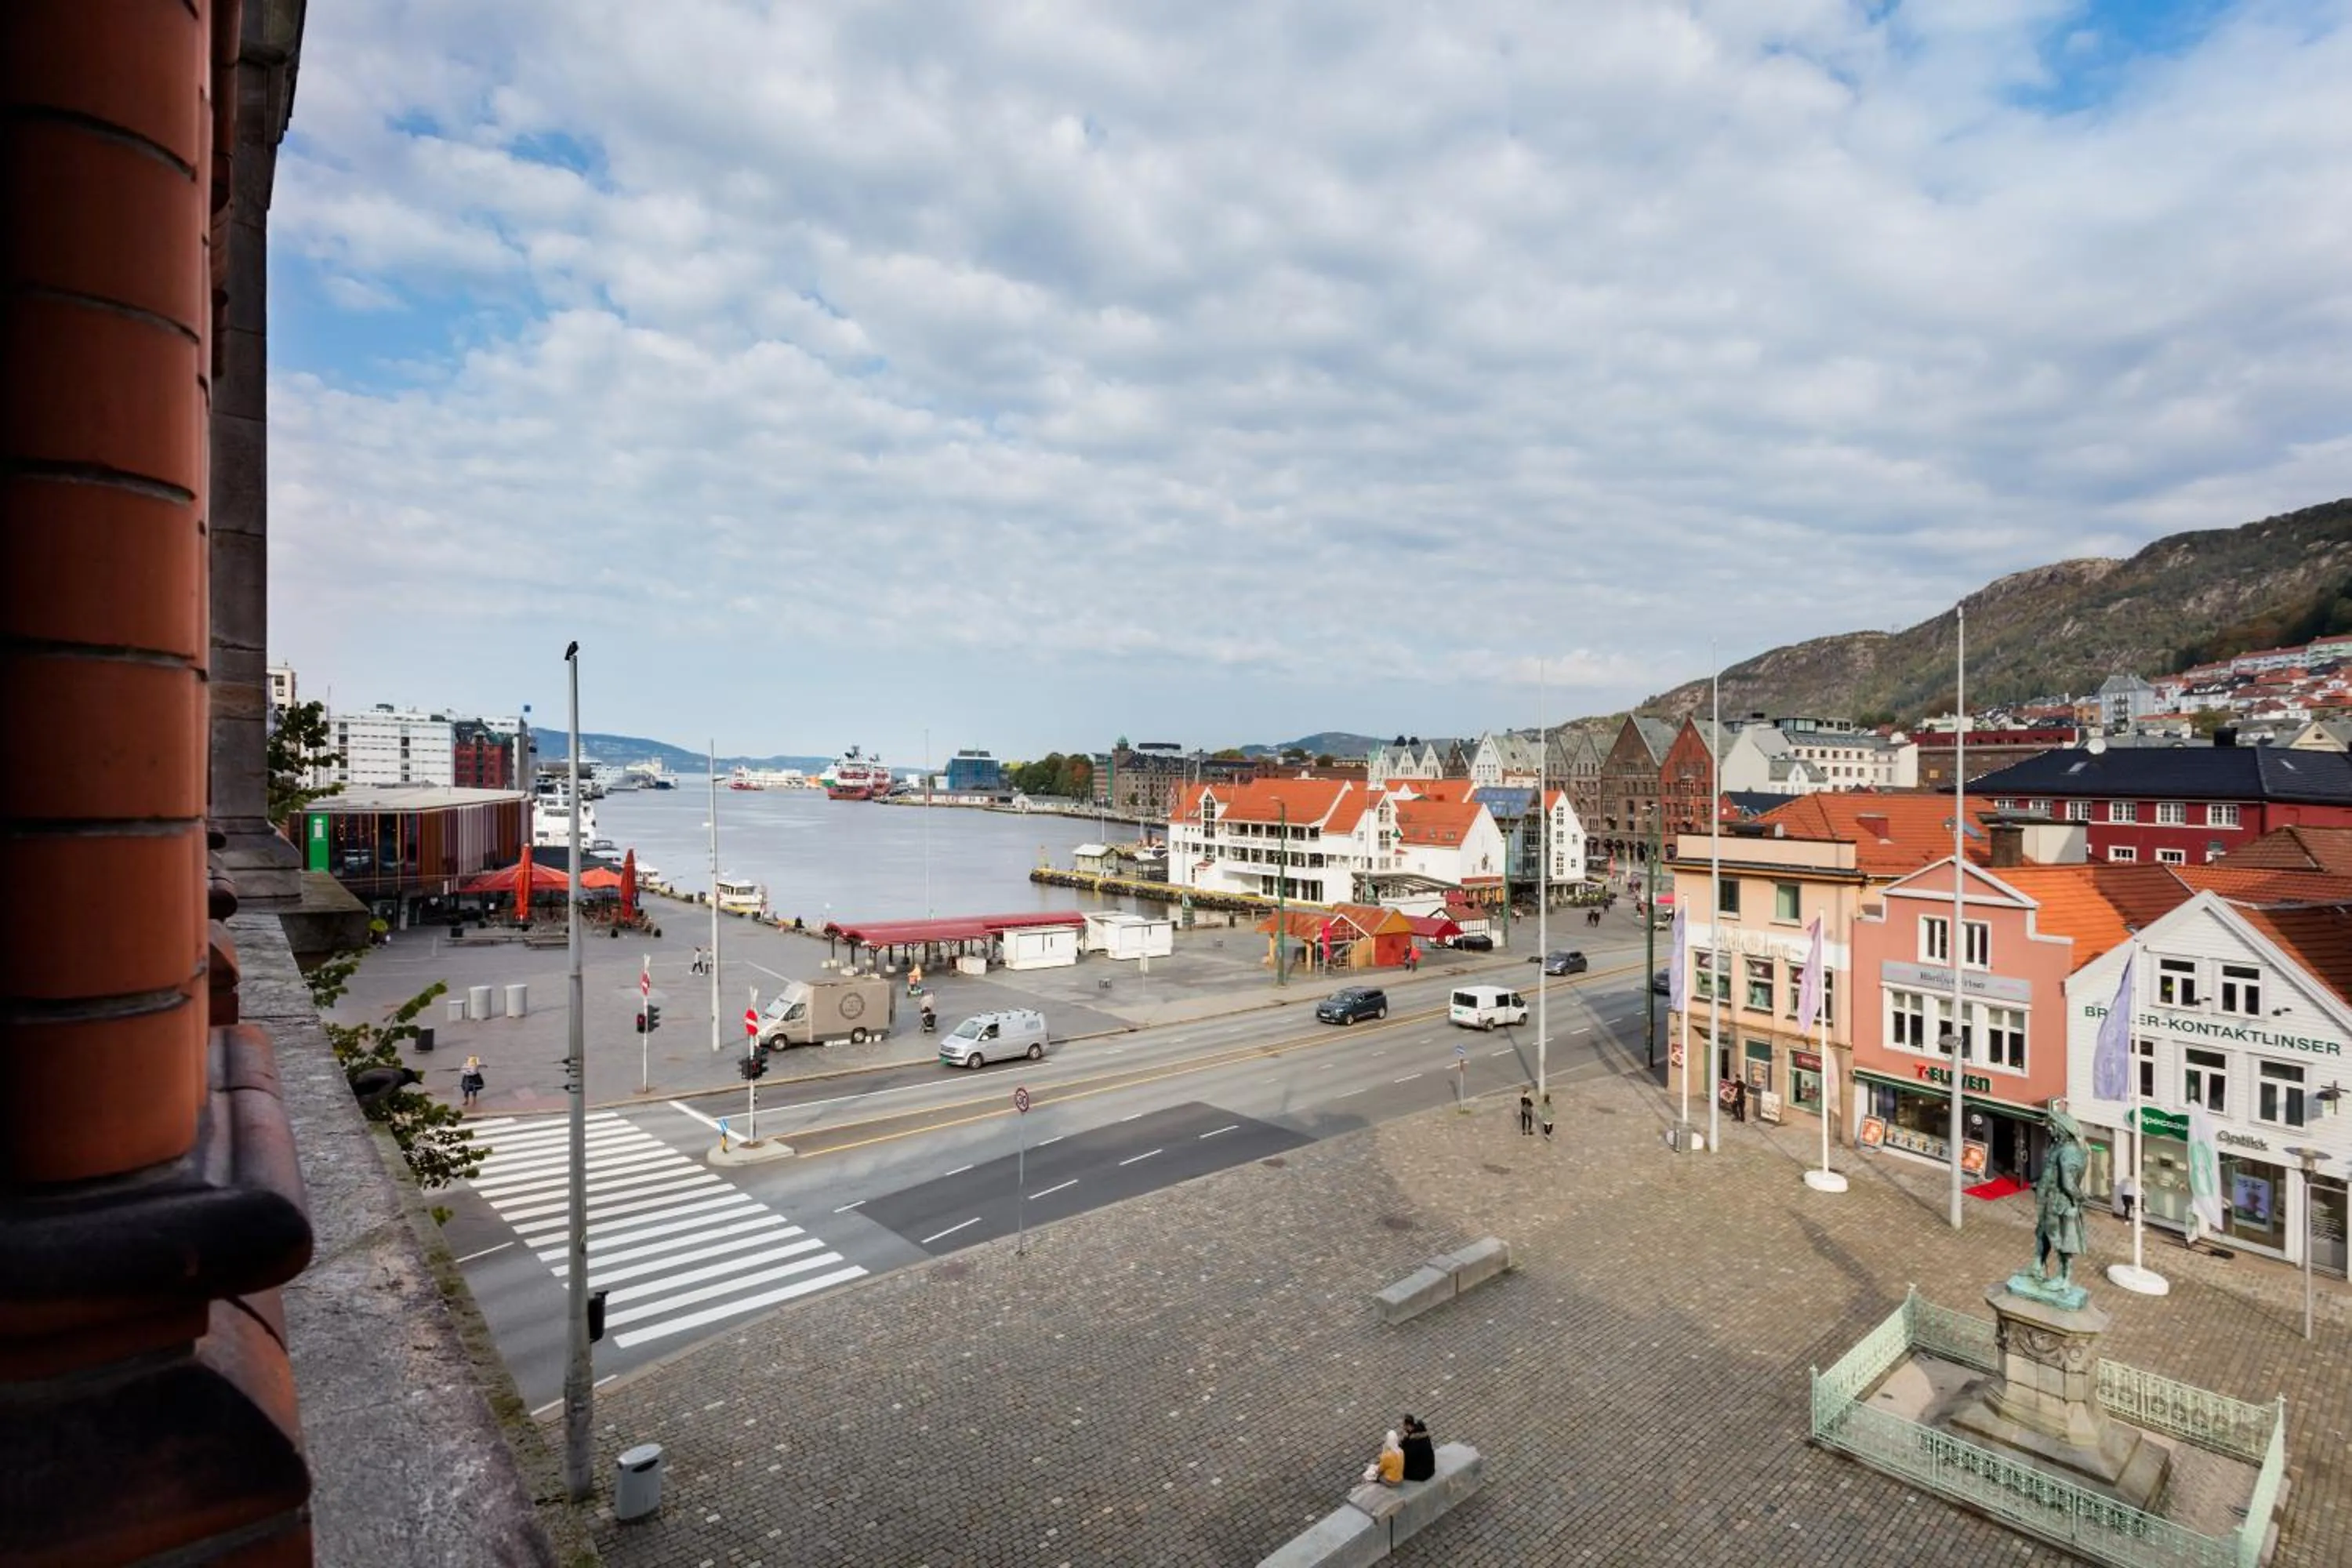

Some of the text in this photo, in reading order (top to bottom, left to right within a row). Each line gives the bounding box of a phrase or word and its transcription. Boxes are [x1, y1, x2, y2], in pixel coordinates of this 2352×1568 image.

[2085, 1005, 2341, 1056] BRER-KONTAKTLINSER
[2141, 1113, 2189, 1131] Specsav
[2216, 1130, 2269, 1152] Optikk
